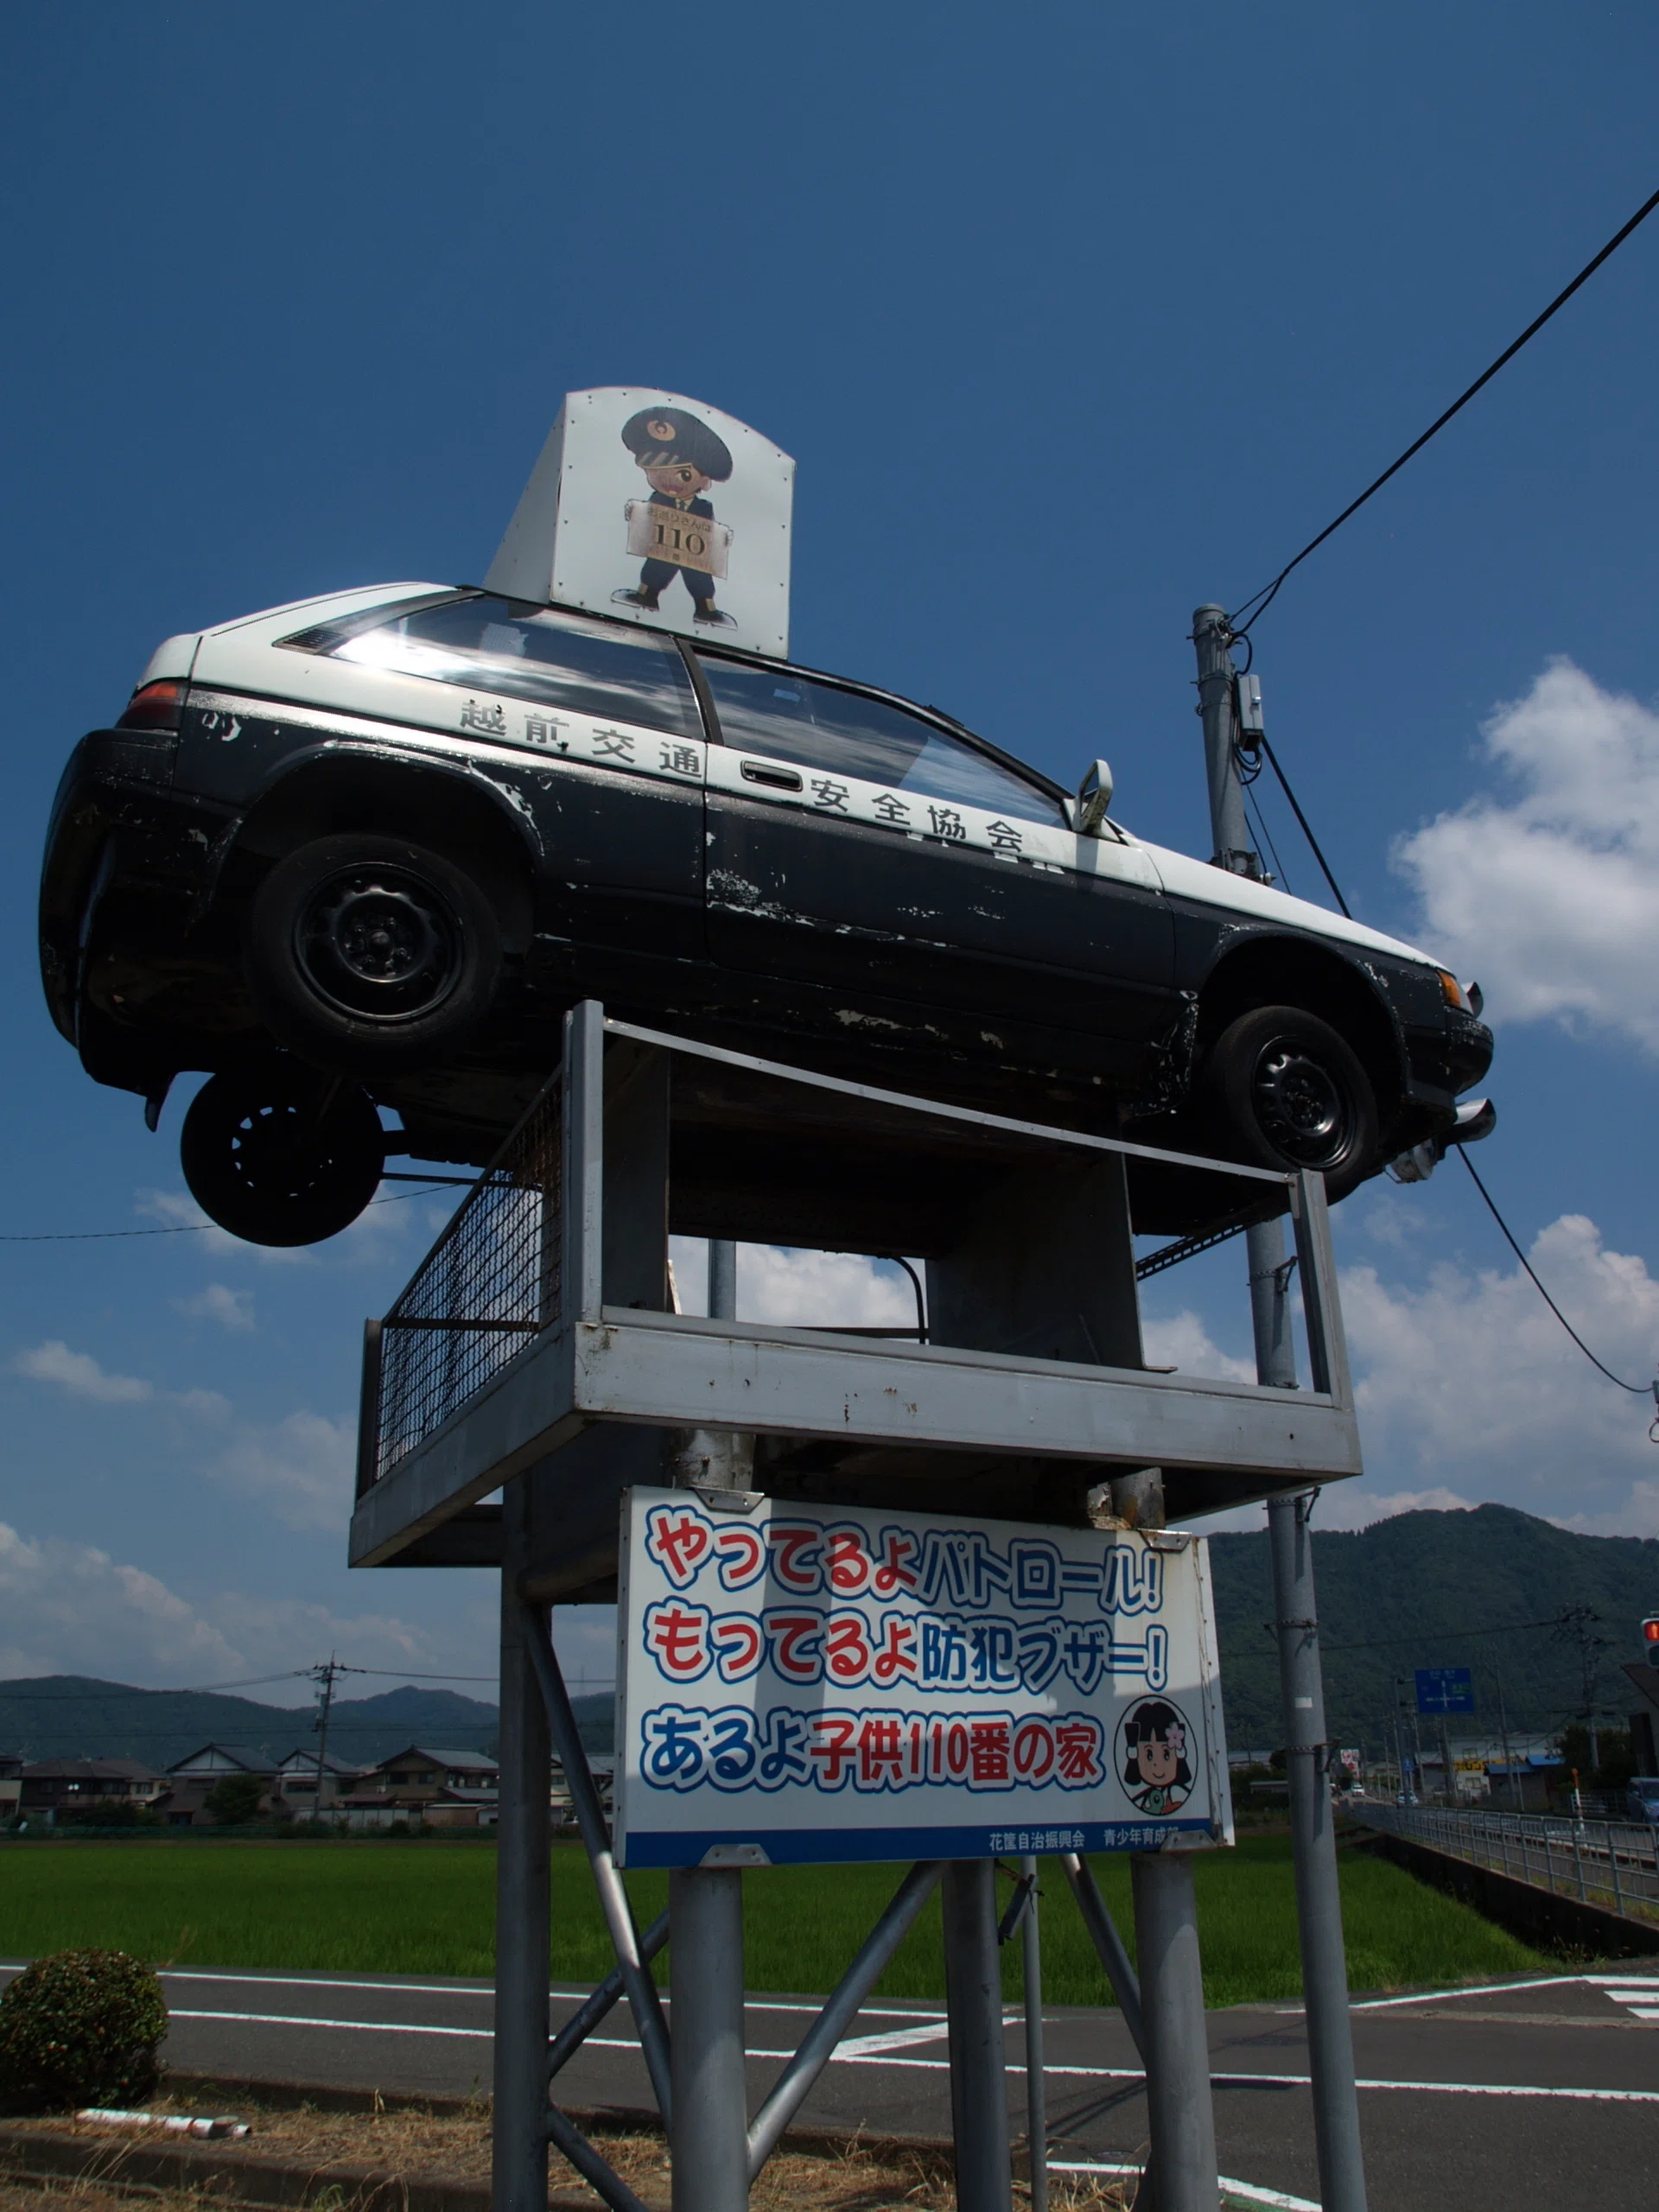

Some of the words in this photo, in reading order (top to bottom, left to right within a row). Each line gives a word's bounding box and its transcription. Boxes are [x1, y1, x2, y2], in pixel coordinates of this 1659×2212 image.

[653, 524, 706, 556] 110
[459, 697, 702, 779] 越前交通
[810, 779, 1024, 854] 安全協会
[641, 1703, 1106, 1792] あるよ子供110番の家
